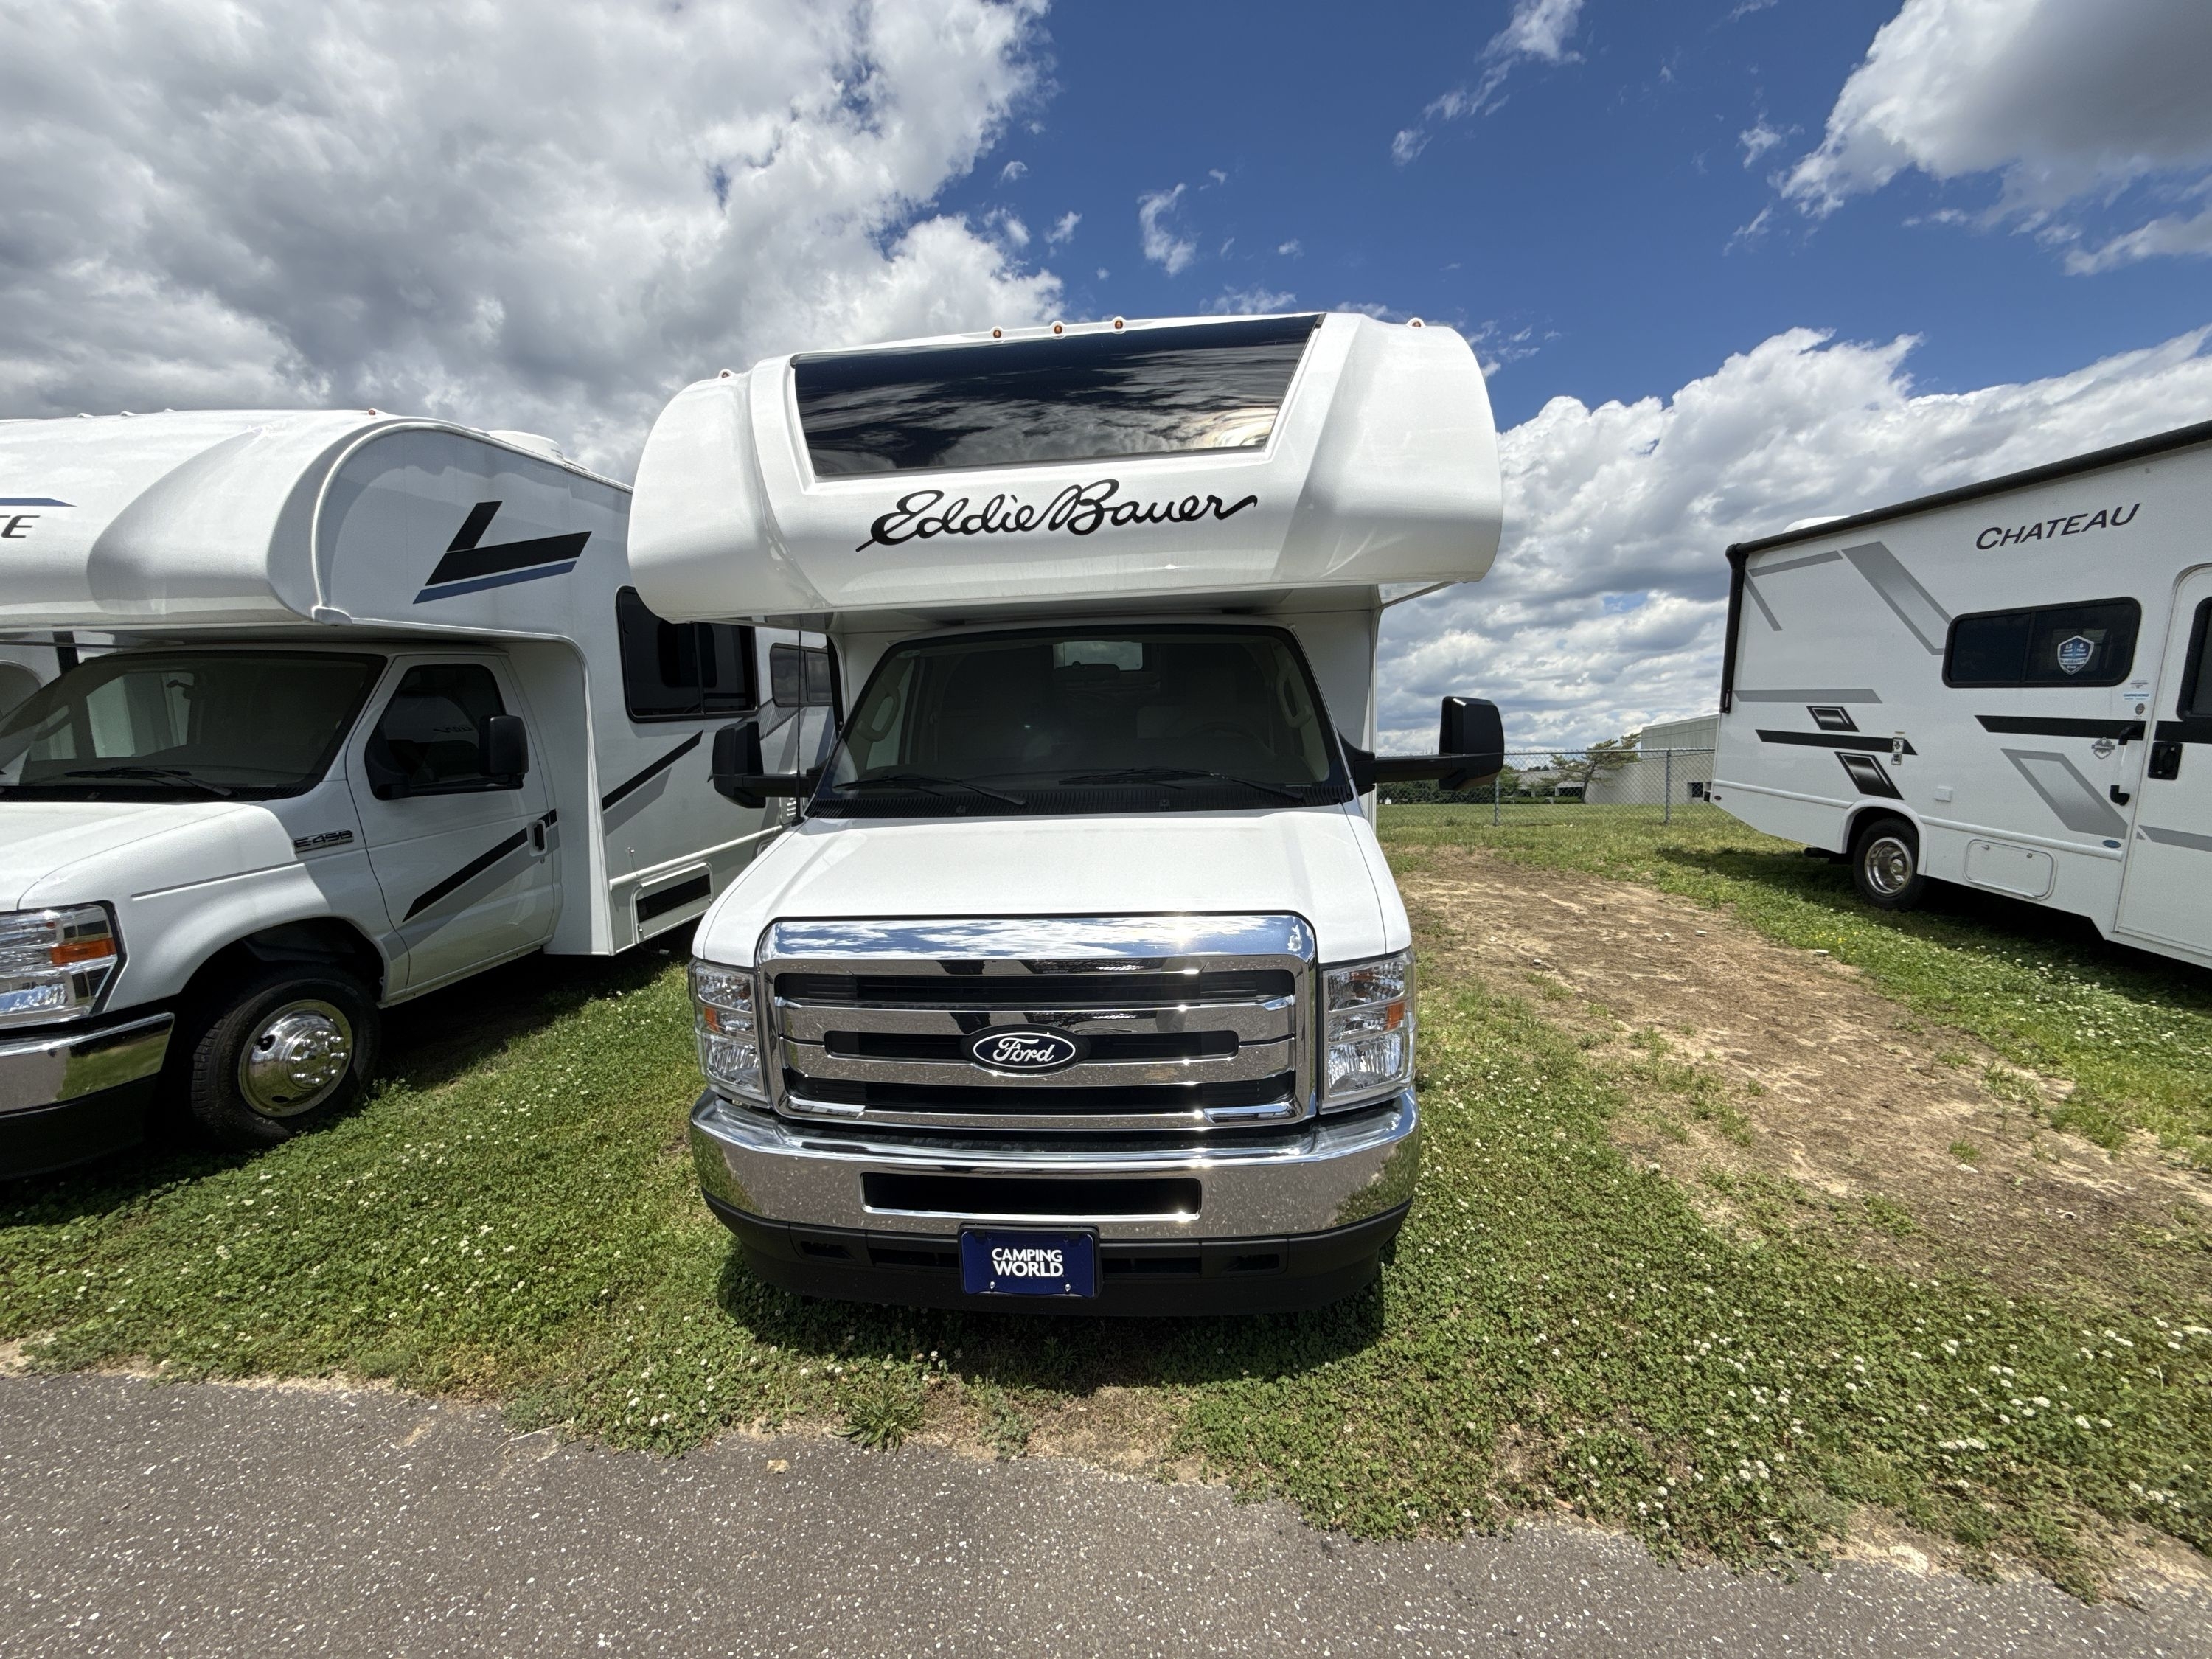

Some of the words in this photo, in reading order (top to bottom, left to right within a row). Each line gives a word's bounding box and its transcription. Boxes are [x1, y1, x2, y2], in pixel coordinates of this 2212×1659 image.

[855, 490, 1034, 552] Eddie
[1047, 479, 1258, 536] Bauer
[1976, 503, 2141, 550] CHATEAU
[992, 1037, 1056, 1062] Ford
[992, 1248, 1062, 1262] CAMPING
[992, 1261, 1064, 1277] WORLD
